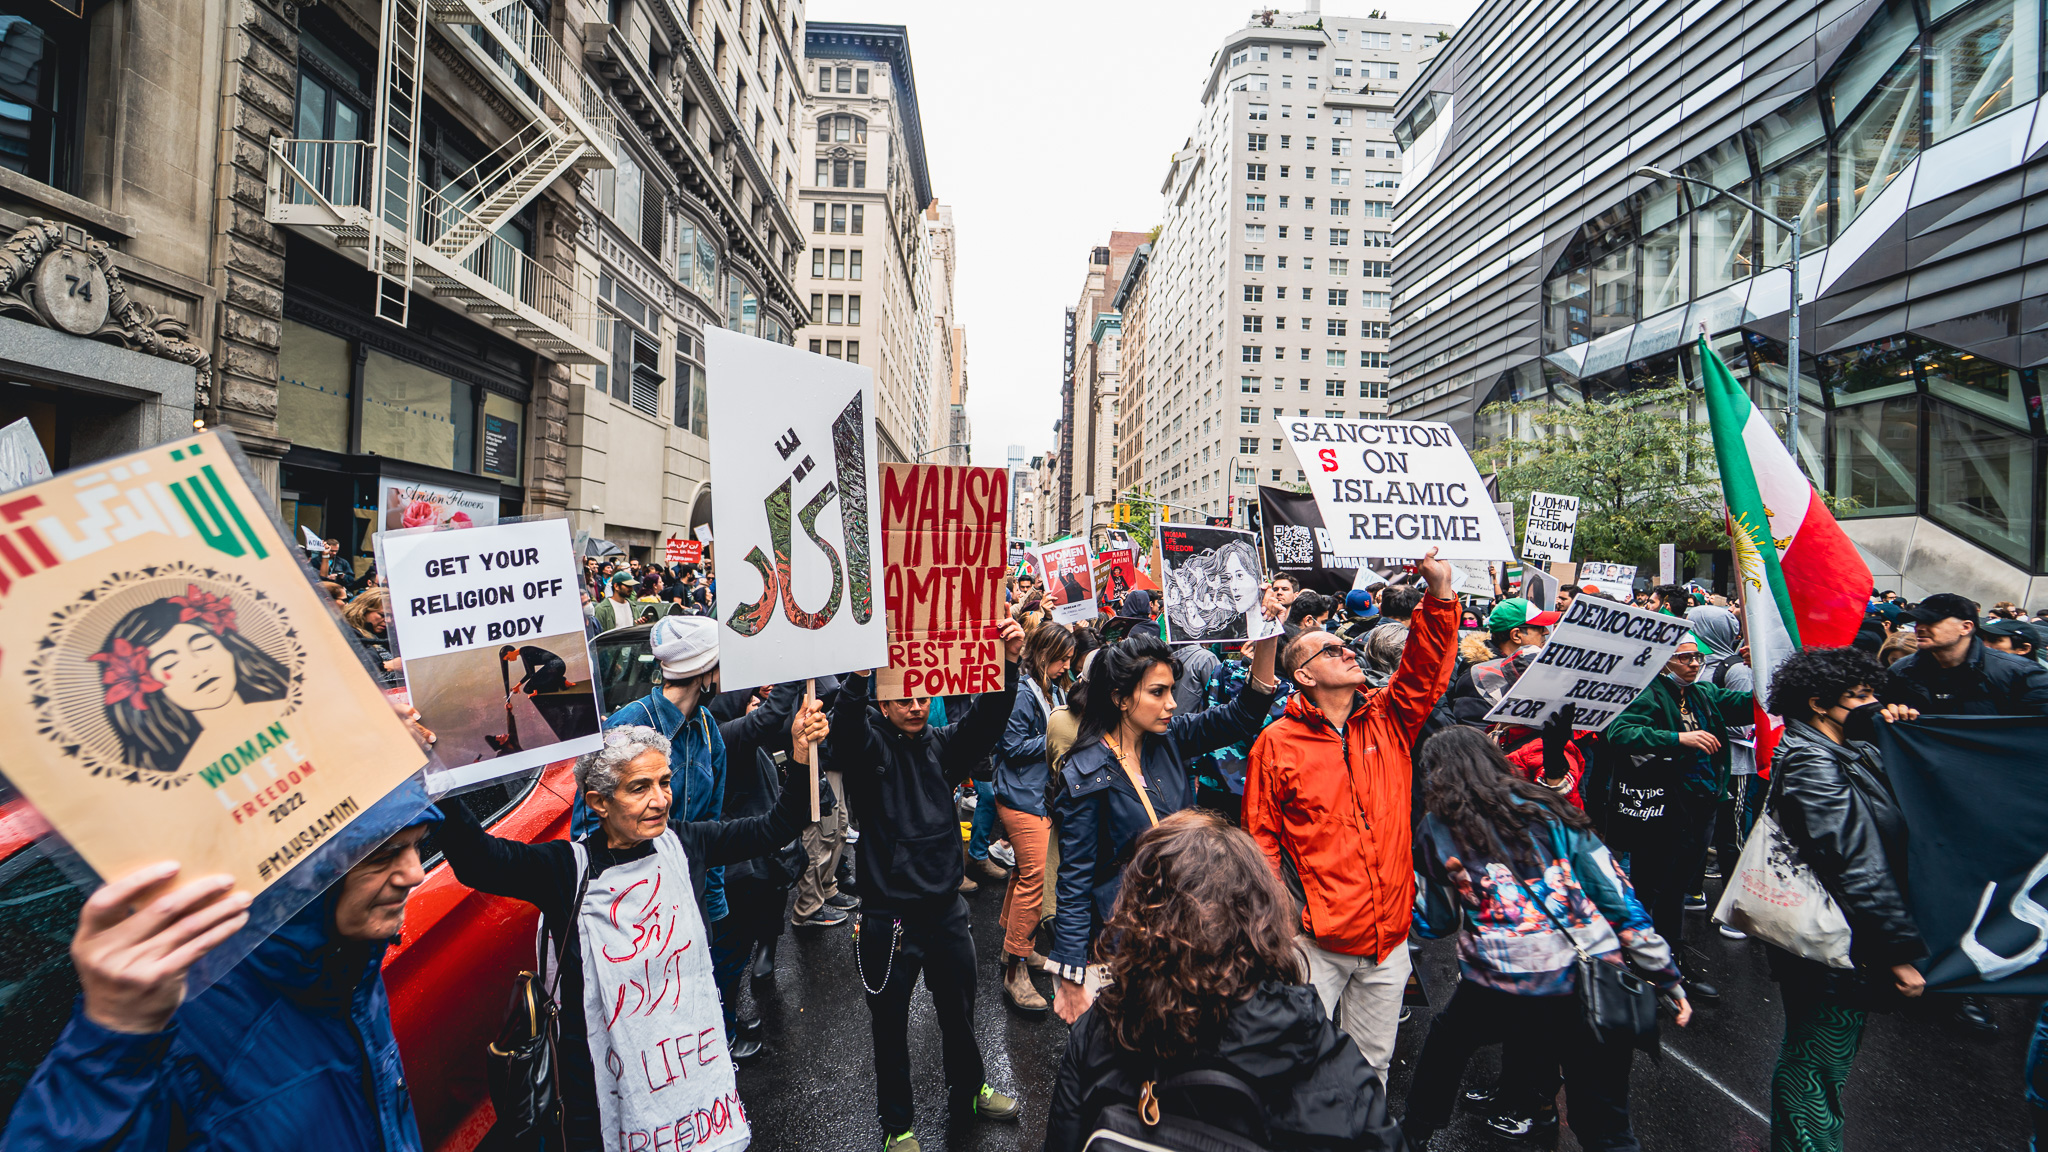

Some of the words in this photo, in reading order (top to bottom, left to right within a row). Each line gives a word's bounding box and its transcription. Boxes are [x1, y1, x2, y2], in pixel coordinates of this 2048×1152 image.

[64, 274, 94, 302] 74
[1291, 422, 1452, 447] SANCTION
[1318, 448, 1339, 473] S
[1363, 449, 1408, 474] ON
[401, 483, 445, 505] Ariston
[446, 489, 484, 510] Flowers
[1333, 479, 1469, 507] ISLAMIC
[1533, 494, 1576, 511] WOMAN
[882, 464, 1008, 567] MAHSA
[1349, 513, 1481, 542] REGIME
[1528, 519, 1574, 533] FREEDOM
[1531, 506, 1561, 521] LIFE
[1164, 531, 1187, 539] WOMAN
[1526, 535, 1547, 548] New
[1549, 537, 1569, 550] York
[424, 555, 470, 578] GET
[479, 548, 540, 572] YOUR
[1044, 546, 1084, 563] WOMEN
[1057, 557, 1076, 568] LIFE
[1112, 550, 1129, 558] MAHSA
[1524, 549, 1551, 561] Iran
[1049, 564, 1087, 579] FREEDOM
[410, 586, 515, 617] RELIGION
[523, 579, 563, 599] OFF
[884, 566, 1006, 643] AMINI
[443, 625, 476, 648] MY
[487, 615, 545, 641] BODY
[1564, 599, 1691, 647] DEMOCRACY
[890, 643, 956, 669] REST
[960, 641, 996, 665] IN
[1538, 642, 1623, 676] HUMAN
[1634, 646, 1652, 668] &
[903, 664, 1001, 698] POWER
[1565, 678, 1642, 706] RIGHTS
[1494, 696, 1546, 719] FOR
[1572, 706, 1615, 727] RAN
[198, 721, 291, 790] WOMAN
[214, 740, 306, 810] LIFE
[231, 760, 316, 824] FREEDOM
[1619, 781, 1635, 796] Her
[1635, 787, 1664, 800] Vibe
[1633, 796, 1642, 807] is
[267, 792, 307, 824] 2022
[1618, 802, 1665, 821] Beautiful
[258, 796, 360, 882] #MAHSAAMINI
[641, 1027, 719, 1094] LIFE
